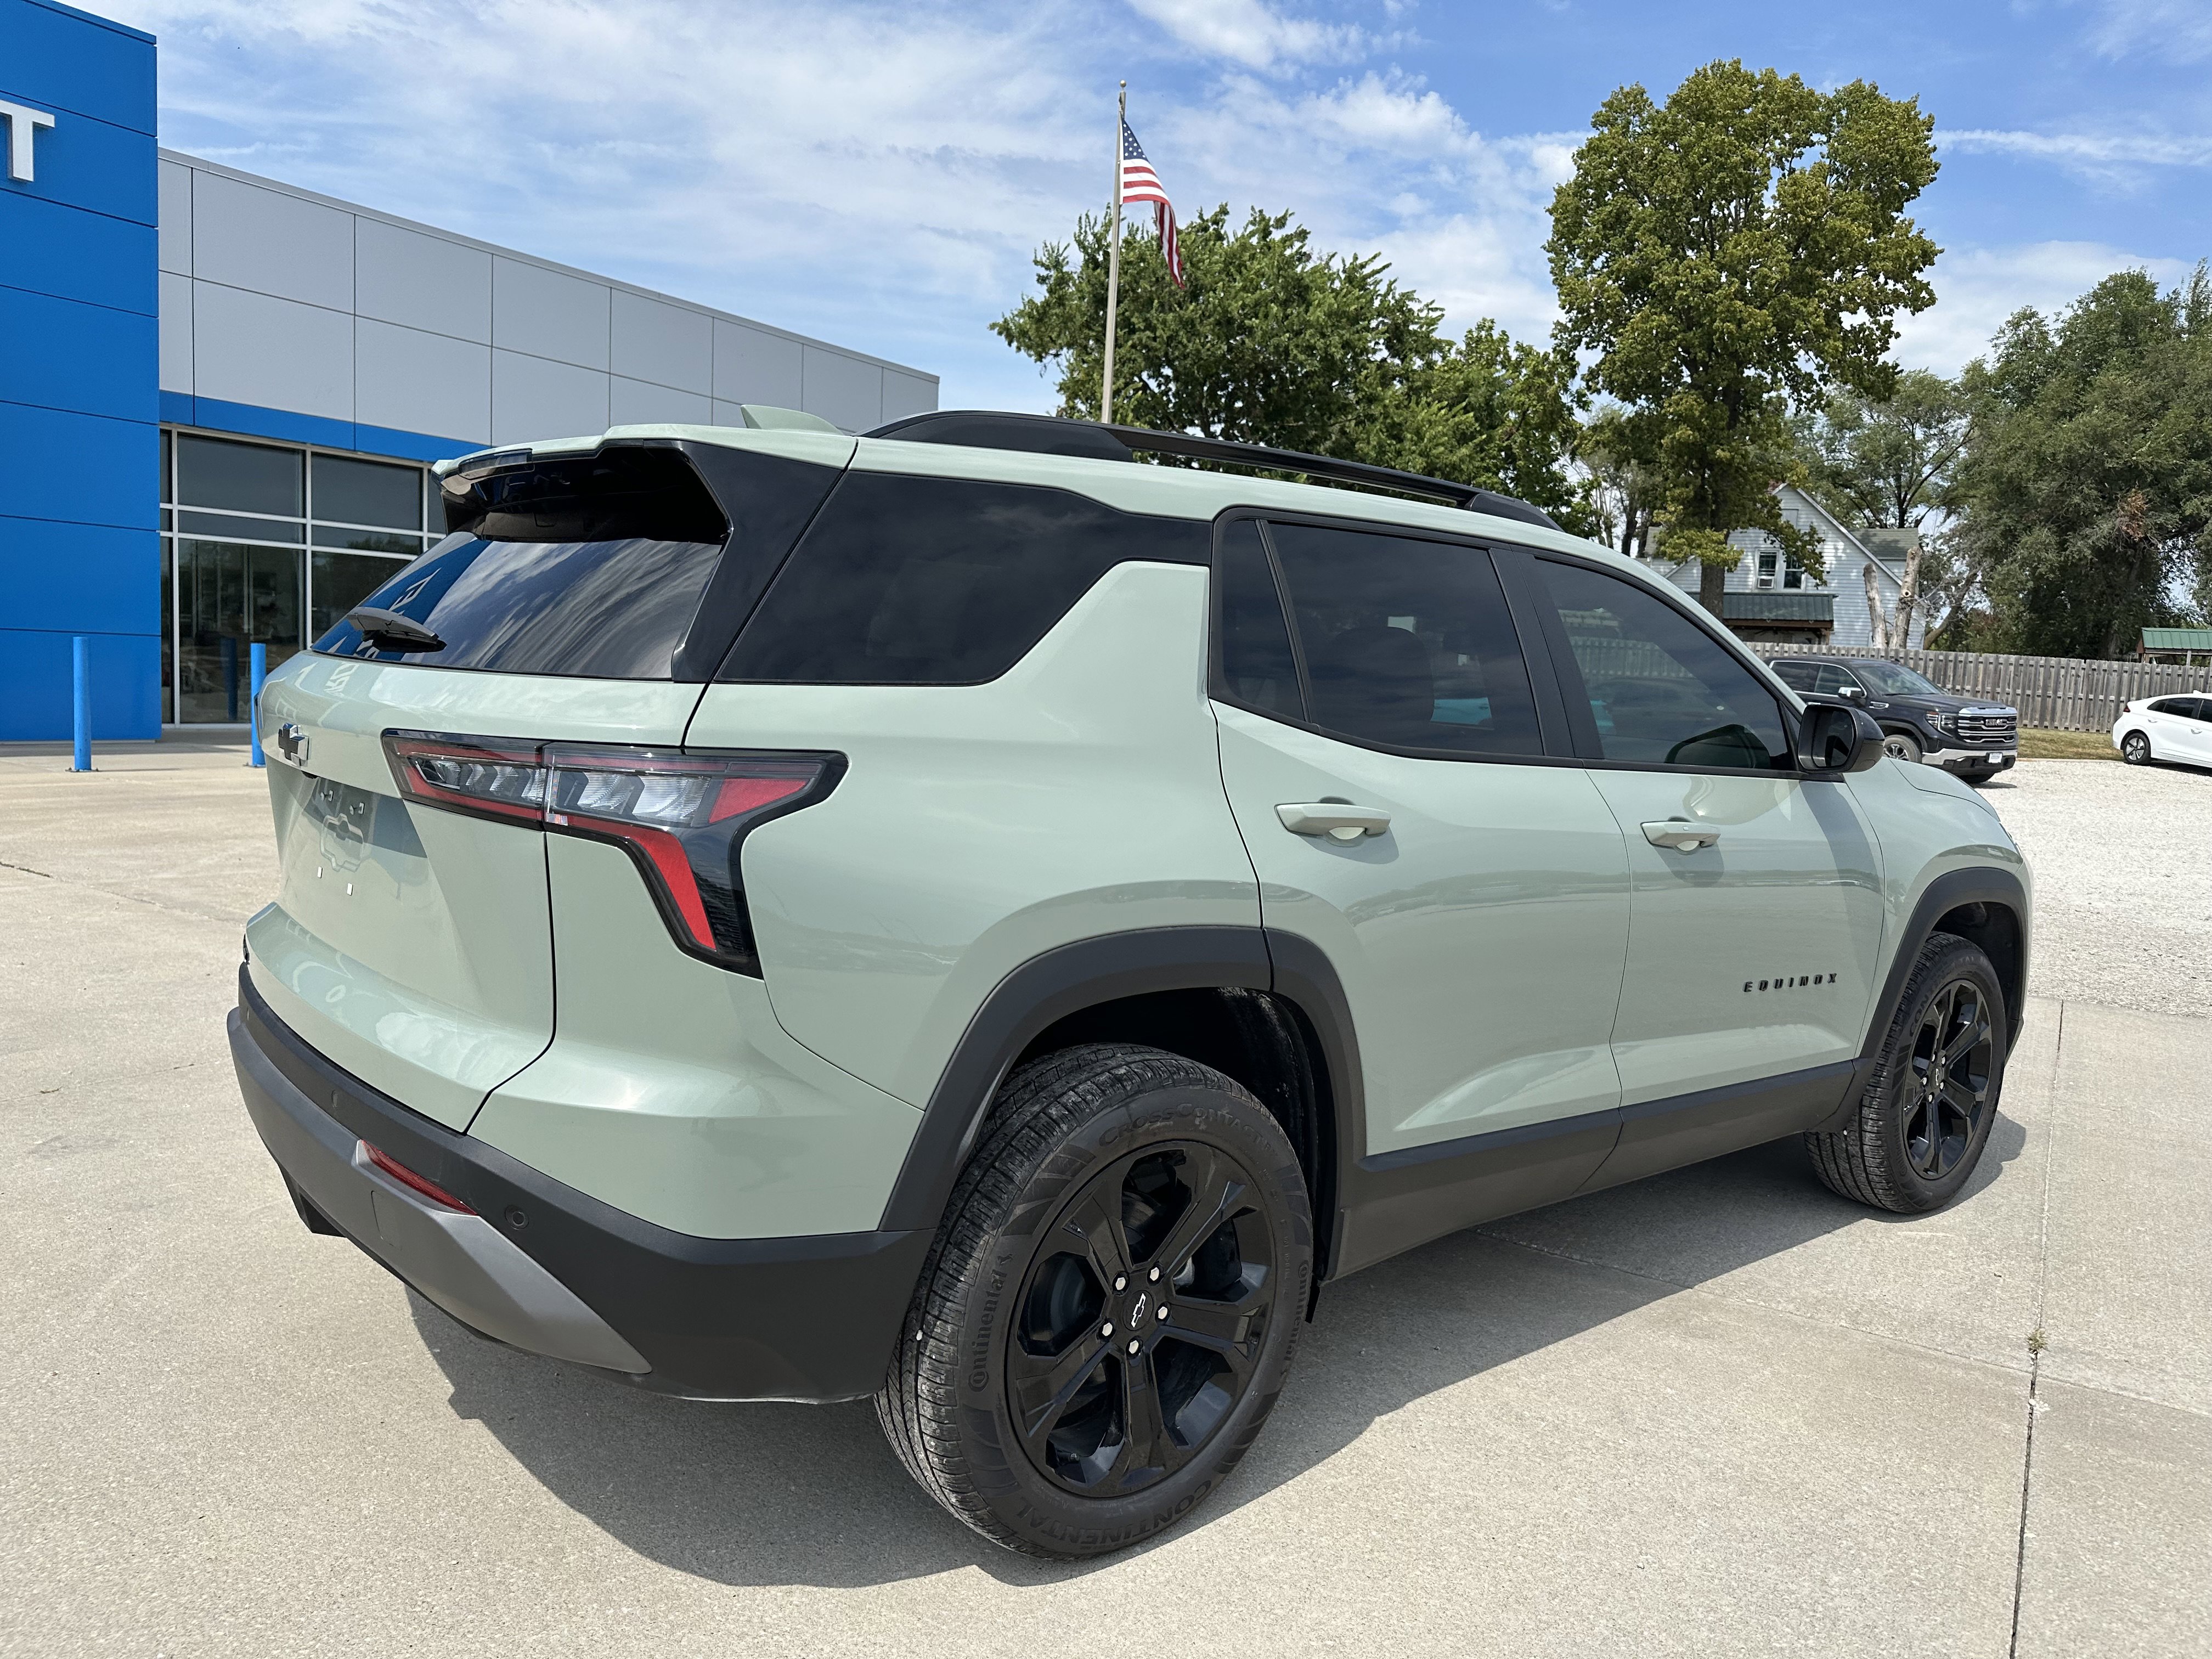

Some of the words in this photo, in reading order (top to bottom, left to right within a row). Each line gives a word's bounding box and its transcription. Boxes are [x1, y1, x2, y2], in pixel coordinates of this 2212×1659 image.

[0, 99, 55, 182] T
[1742, 973, 1837, 992] EQUINOX
[968, 1269, 1007, 1392] Continental
